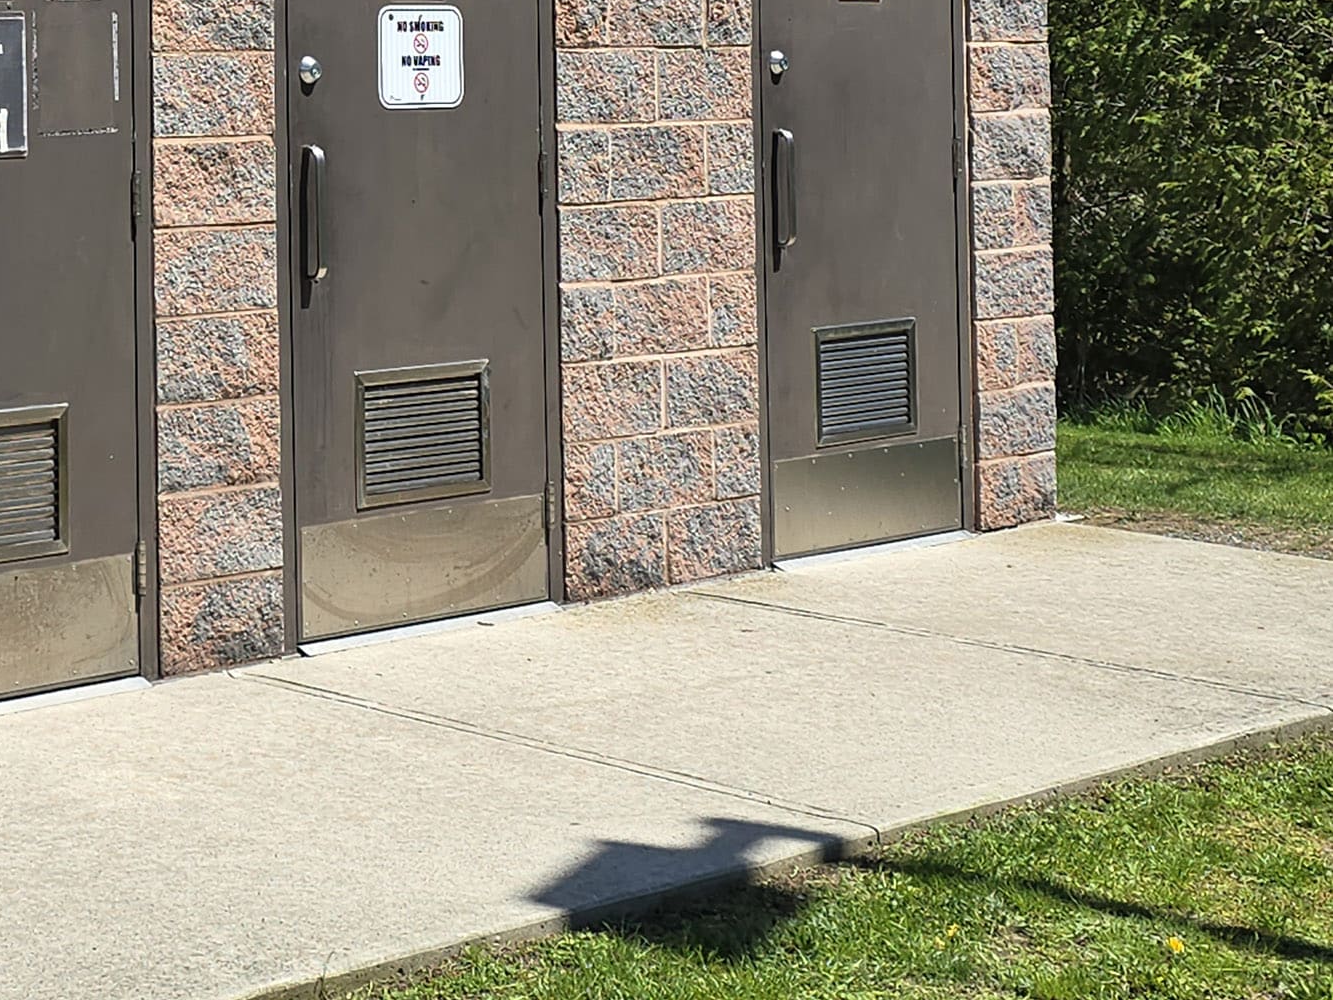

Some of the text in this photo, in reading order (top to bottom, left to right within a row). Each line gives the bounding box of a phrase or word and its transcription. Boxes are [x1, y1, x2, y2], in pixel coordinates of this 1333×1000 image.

[397, 21, 444, 32] NO SMOKING
[401, 55, 440, 67] NO VAPING
